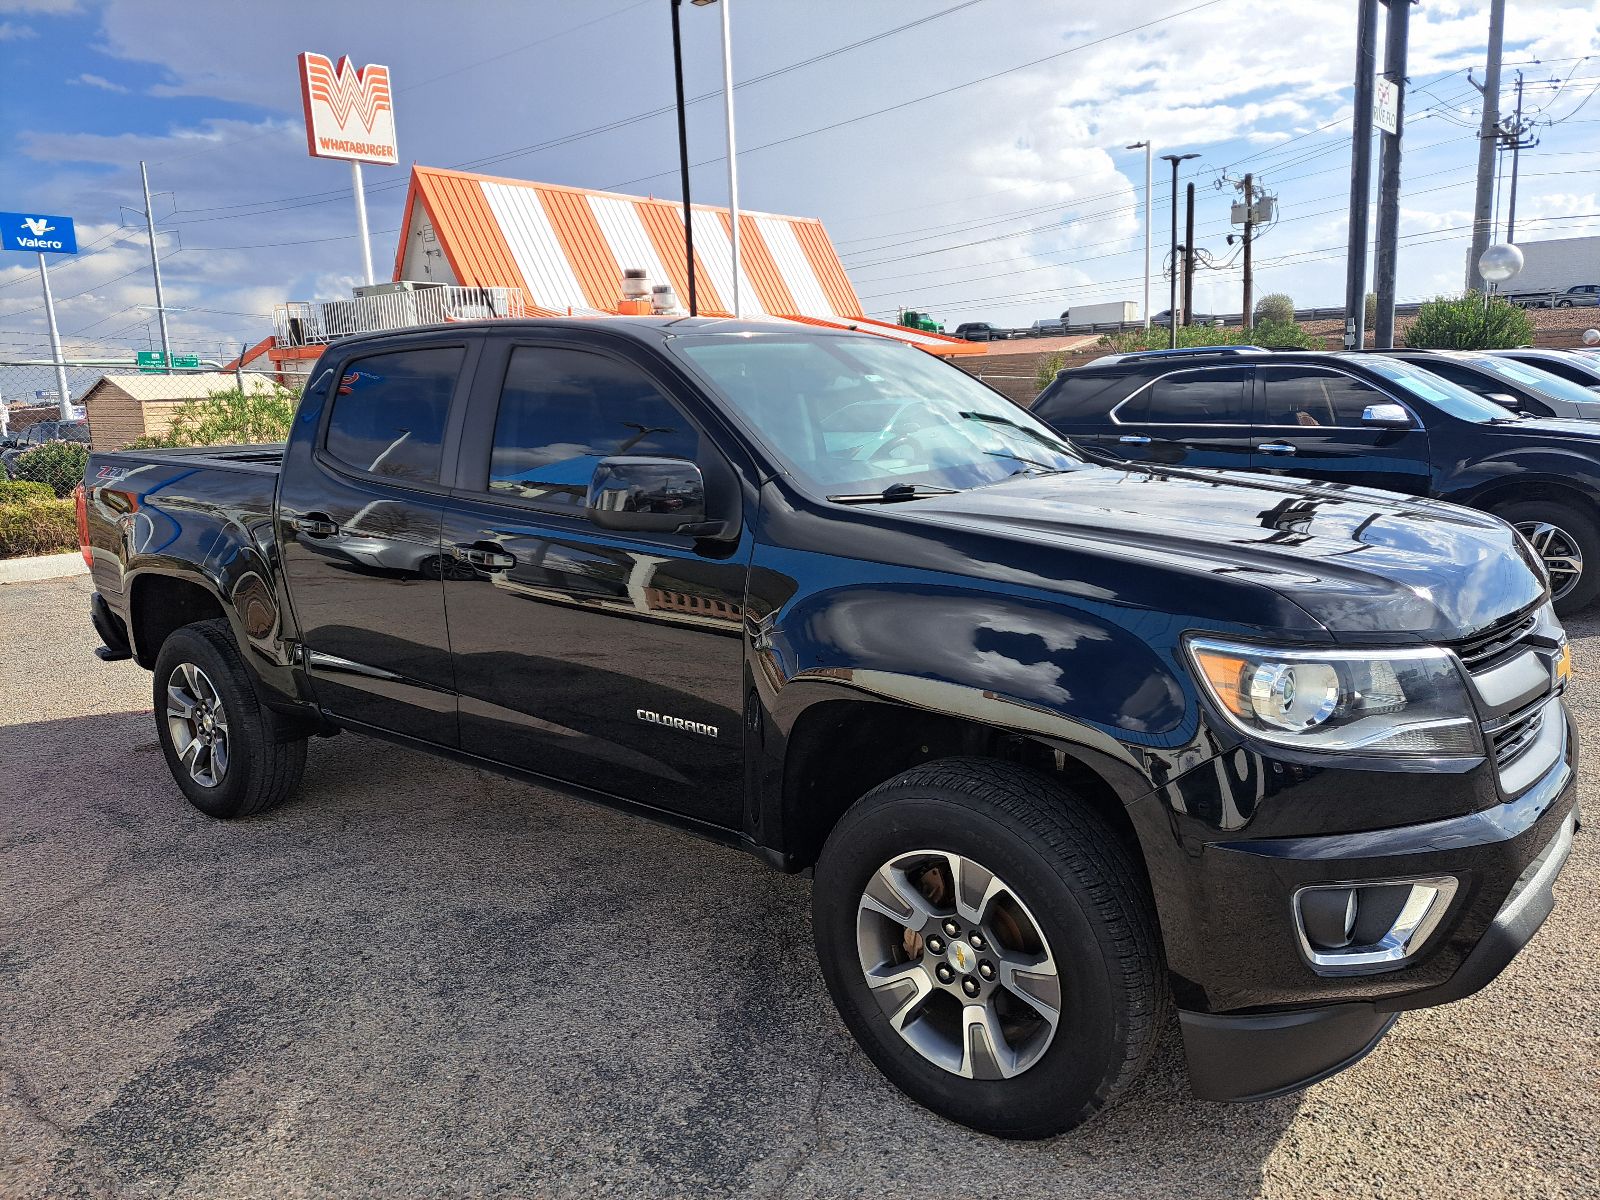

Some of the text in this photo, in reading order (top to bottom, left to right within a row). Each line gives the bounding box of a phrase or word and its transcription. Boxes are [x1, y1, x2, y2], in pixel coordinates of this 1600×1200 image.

[319, 137, 393, 157] WHATABURGER
[16, 236, 62, 249] Valero
[96, 465, 129, 482] Z71
[636, 708, 718, 738] COLORADO
